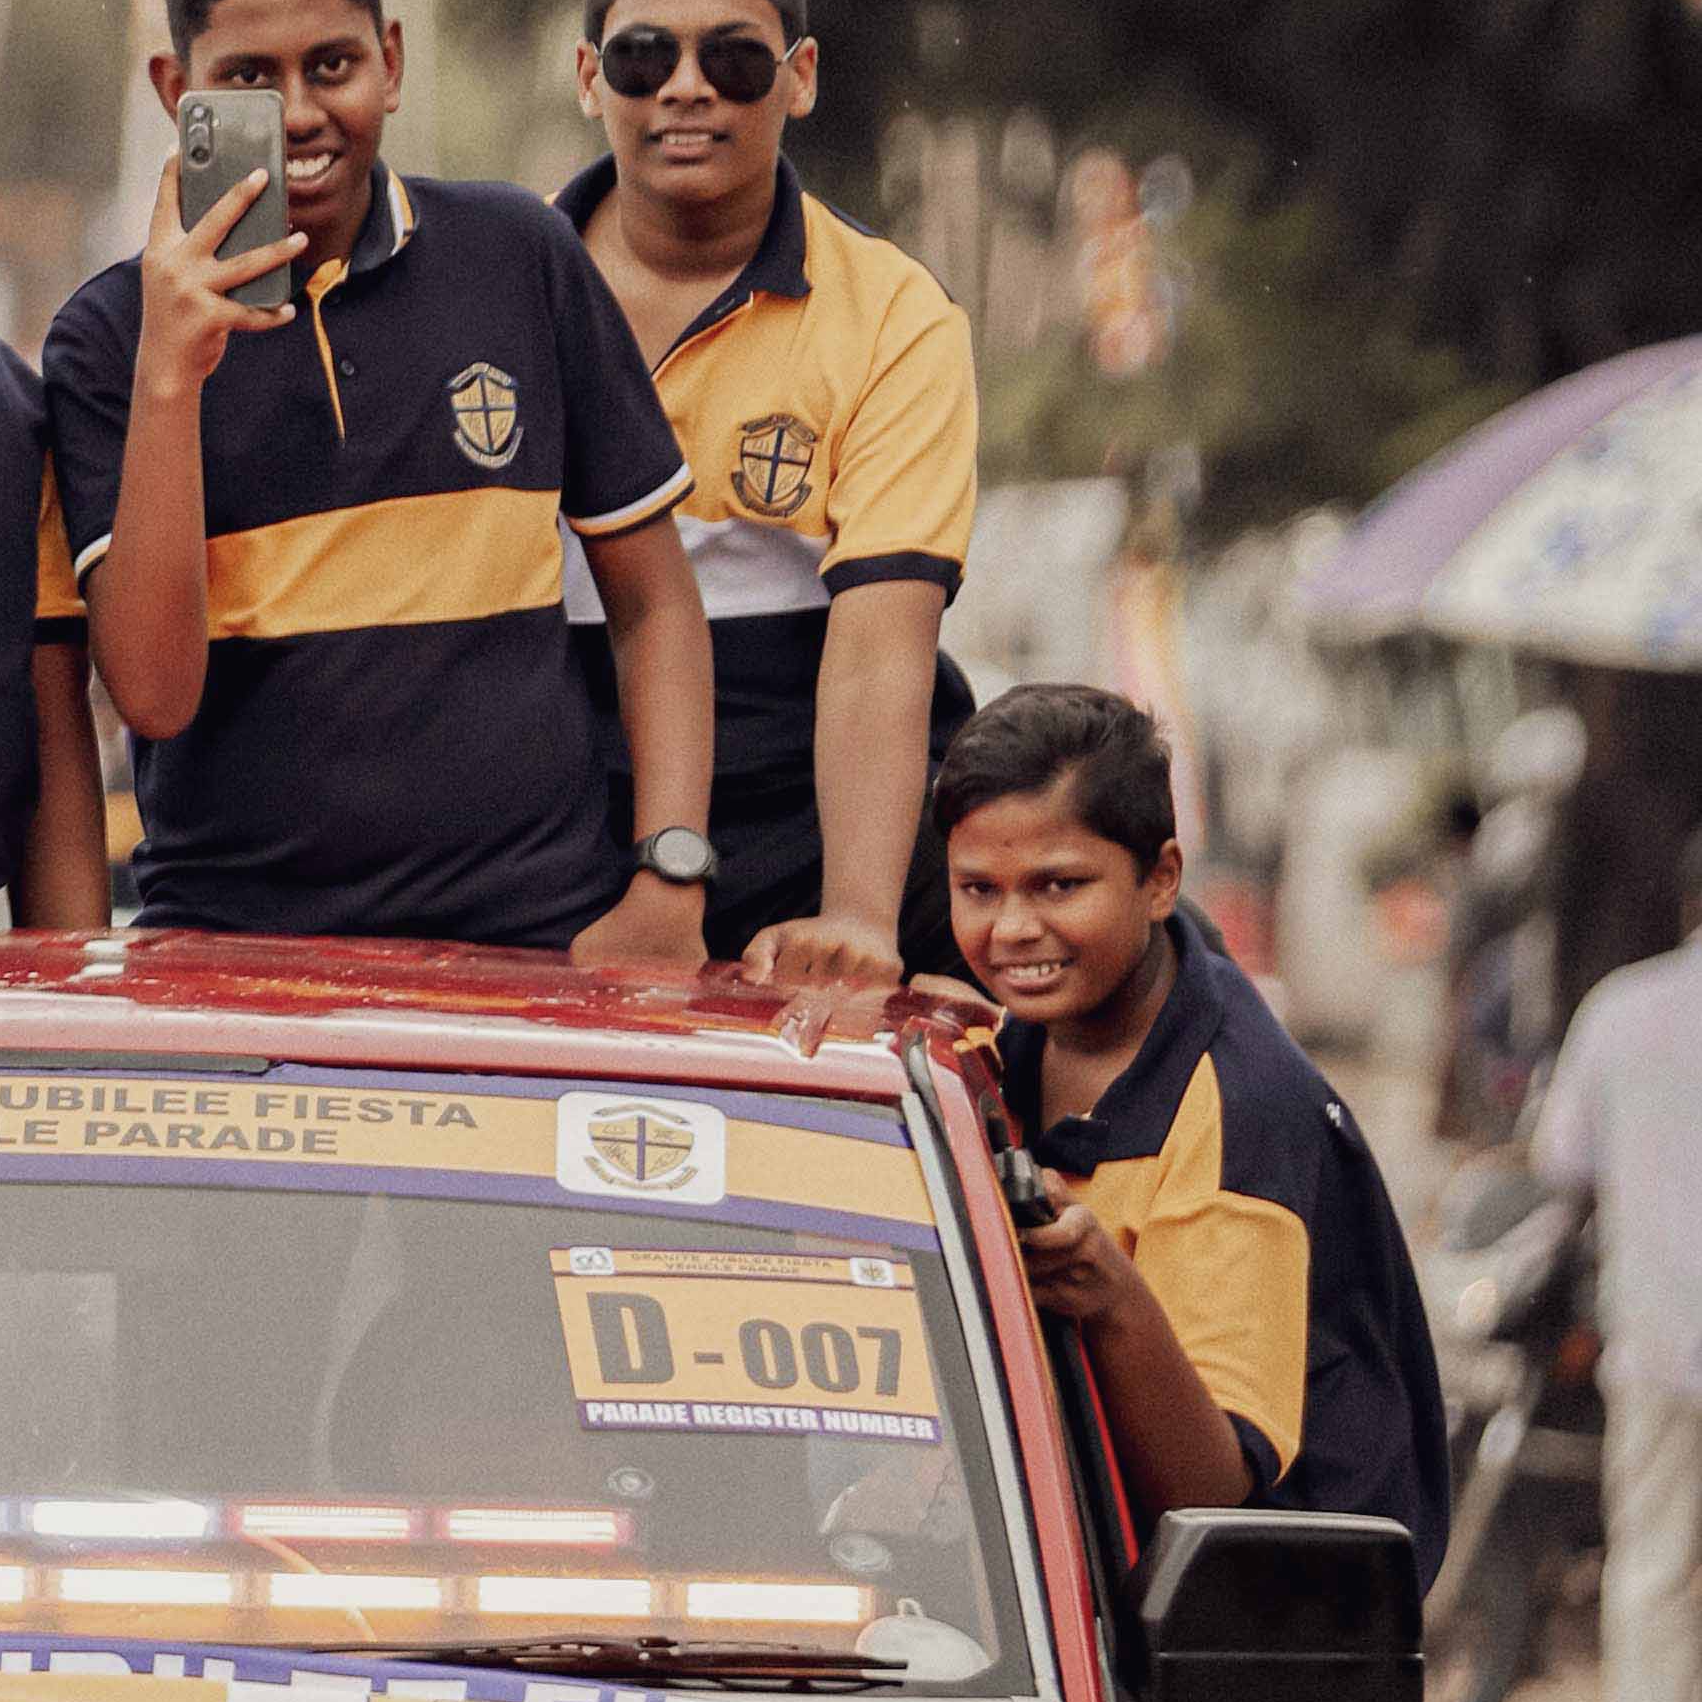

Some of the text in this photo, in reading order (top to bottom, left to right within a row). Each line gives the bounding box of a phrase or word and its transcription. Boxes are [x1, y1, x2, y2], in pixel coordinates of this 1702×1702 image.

[254, 1092, 479, 1128] FIESTA
[84, 1120, 339, 1155] PARADE
[586, 1291, 675, 1384] D
[738, 1318, 903, 1397] 007
[586, 1402, 934, 1441] PARADE REGISTER NUMBER
